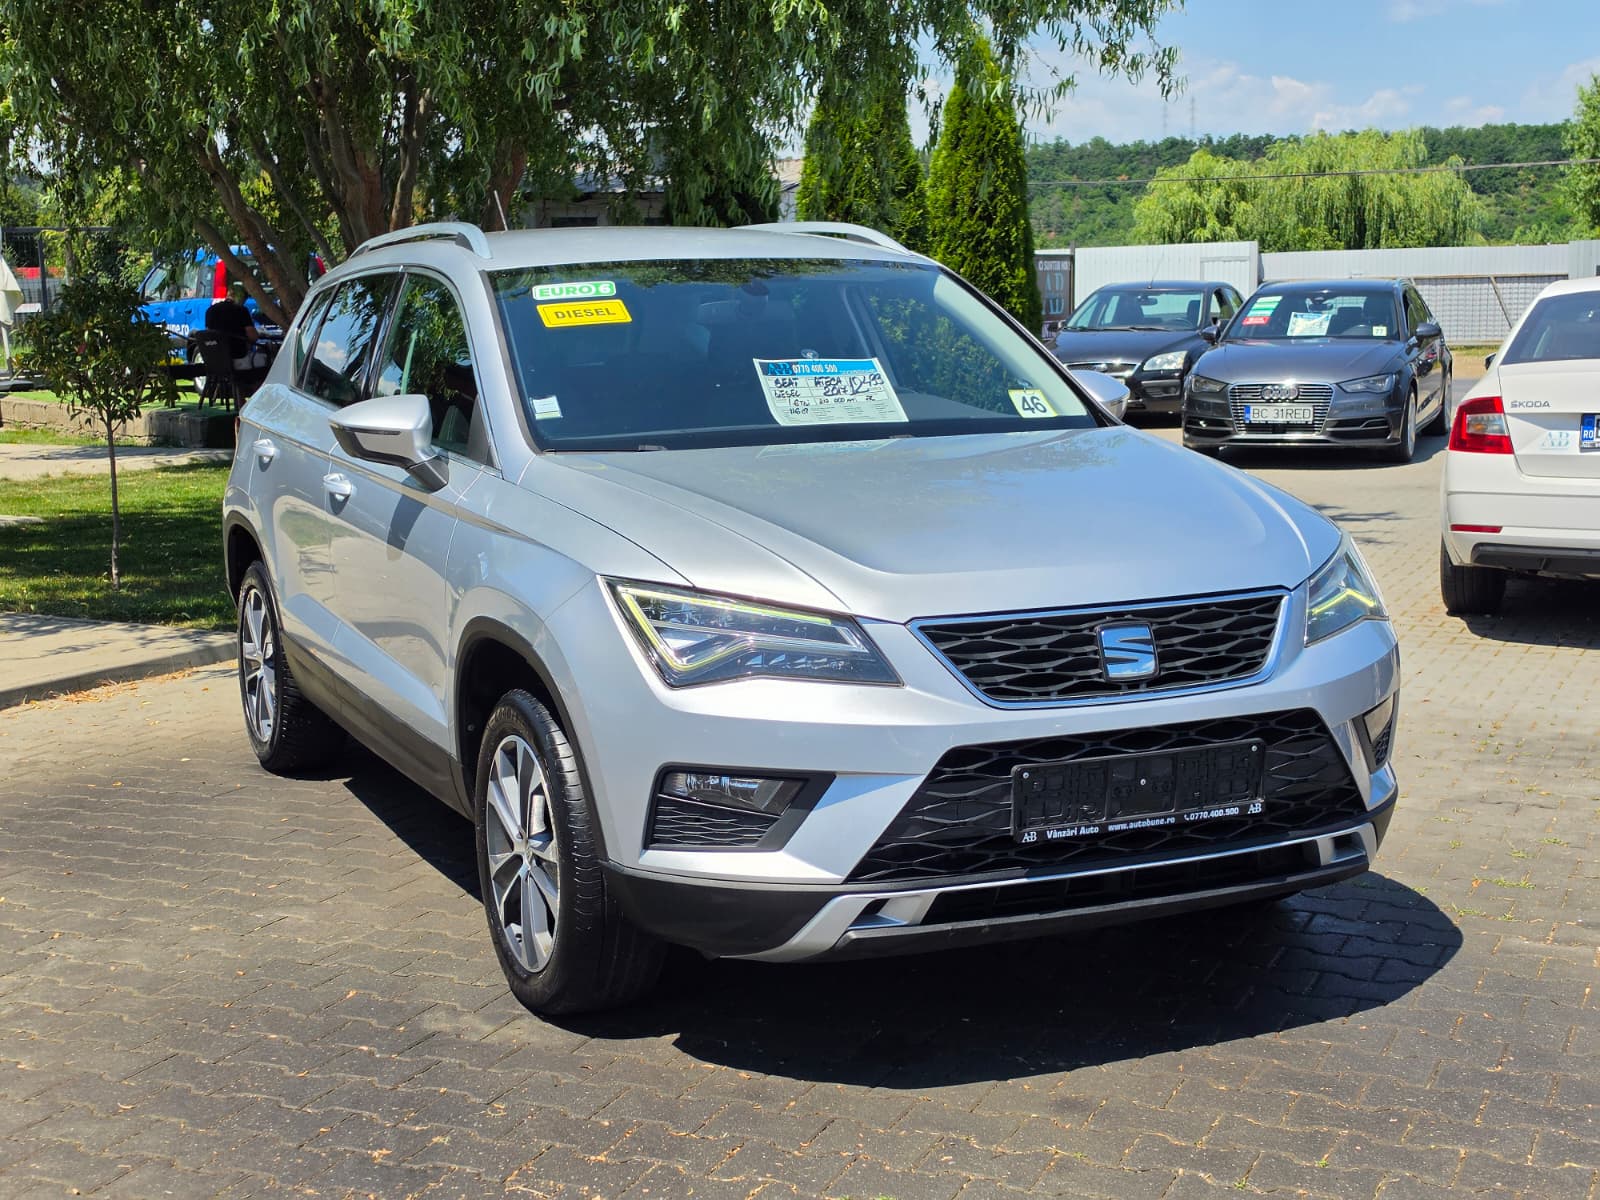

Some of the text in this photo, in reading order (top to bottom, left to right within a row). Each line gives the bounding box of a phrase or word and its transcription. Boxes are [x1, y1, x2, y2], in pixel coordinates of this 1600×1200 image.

[538, 282, 611, 297] EURO 6
[554, 307, 617, 320] DIESEL
[1021, 395, 1047, 414] 46
[1252, 408, 1268, 419] BC
[1583, 429, 1594, 439] RO
[1080, 826, 1099, 835] Auto
[1108, 817, 1175, 831] www.autobune.ro
